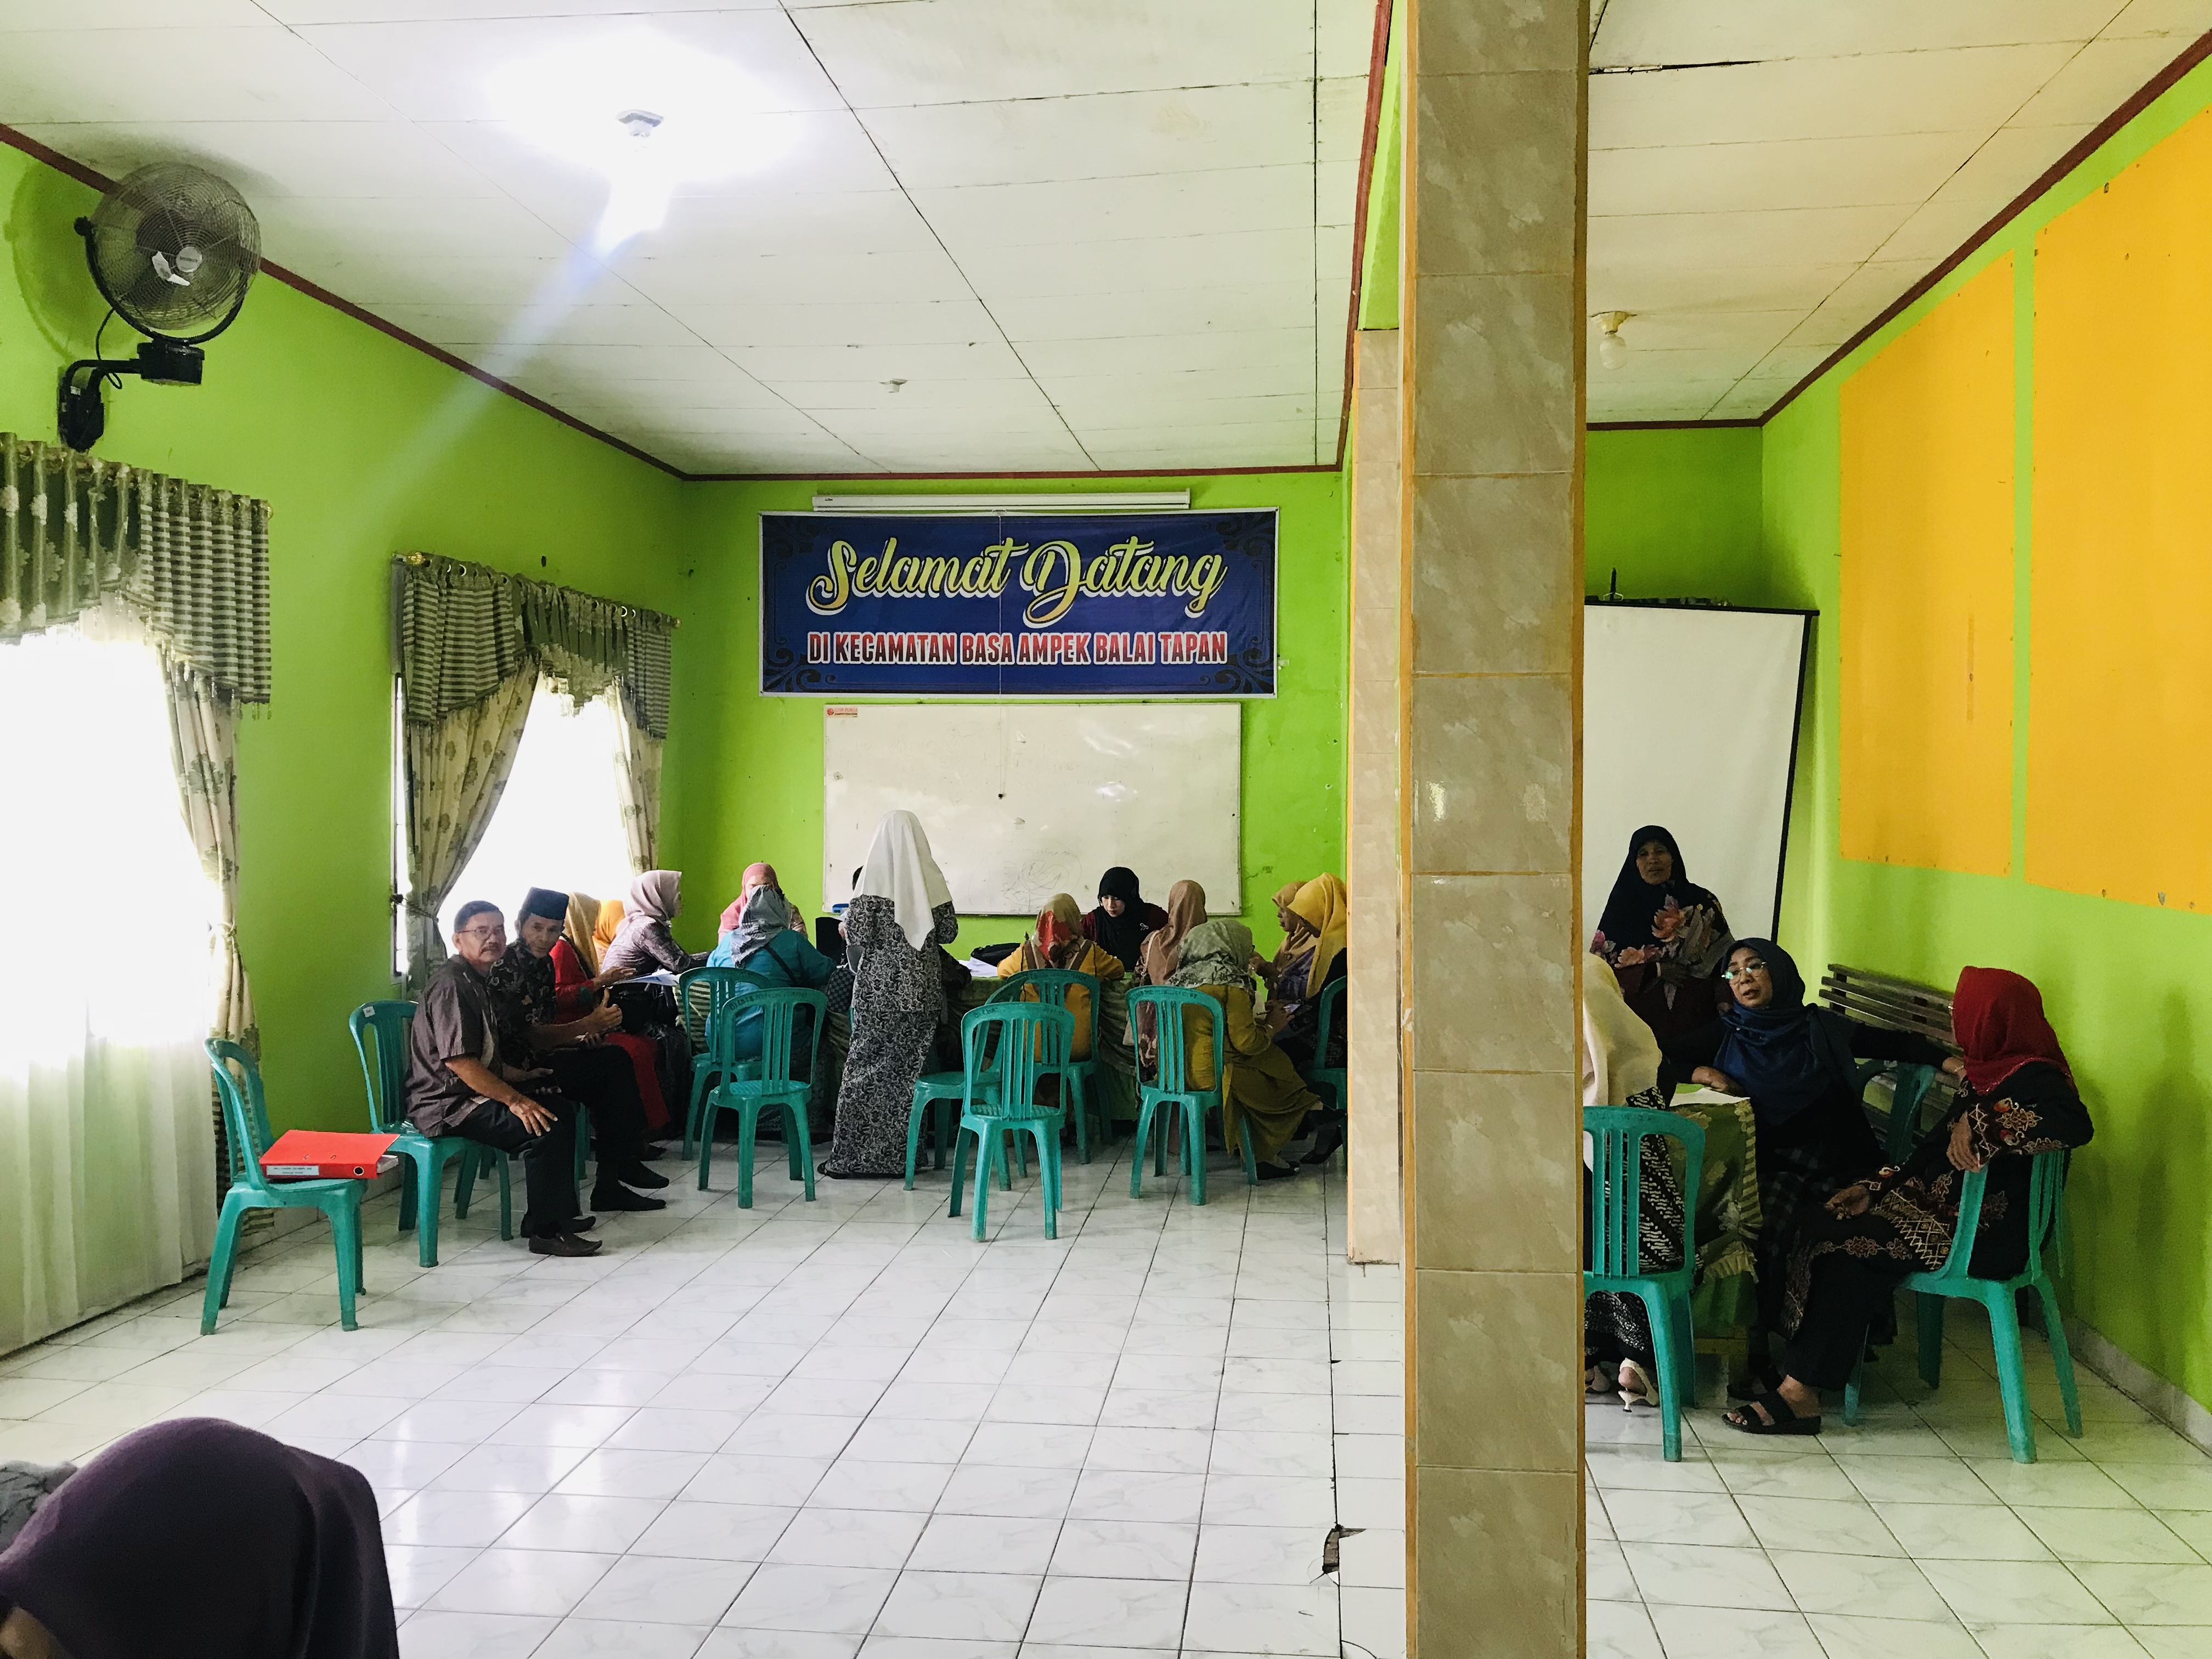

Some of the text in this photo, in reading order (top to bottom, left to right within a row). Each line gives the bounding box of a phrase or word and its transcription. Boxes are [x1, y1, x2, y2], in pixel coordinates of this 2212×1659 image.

[806, 535, 1228, 628] Selamat Datang
[808, 631, 1228, 665] DI KECAMATAN BASA AMPEK BALAI TAPAN
